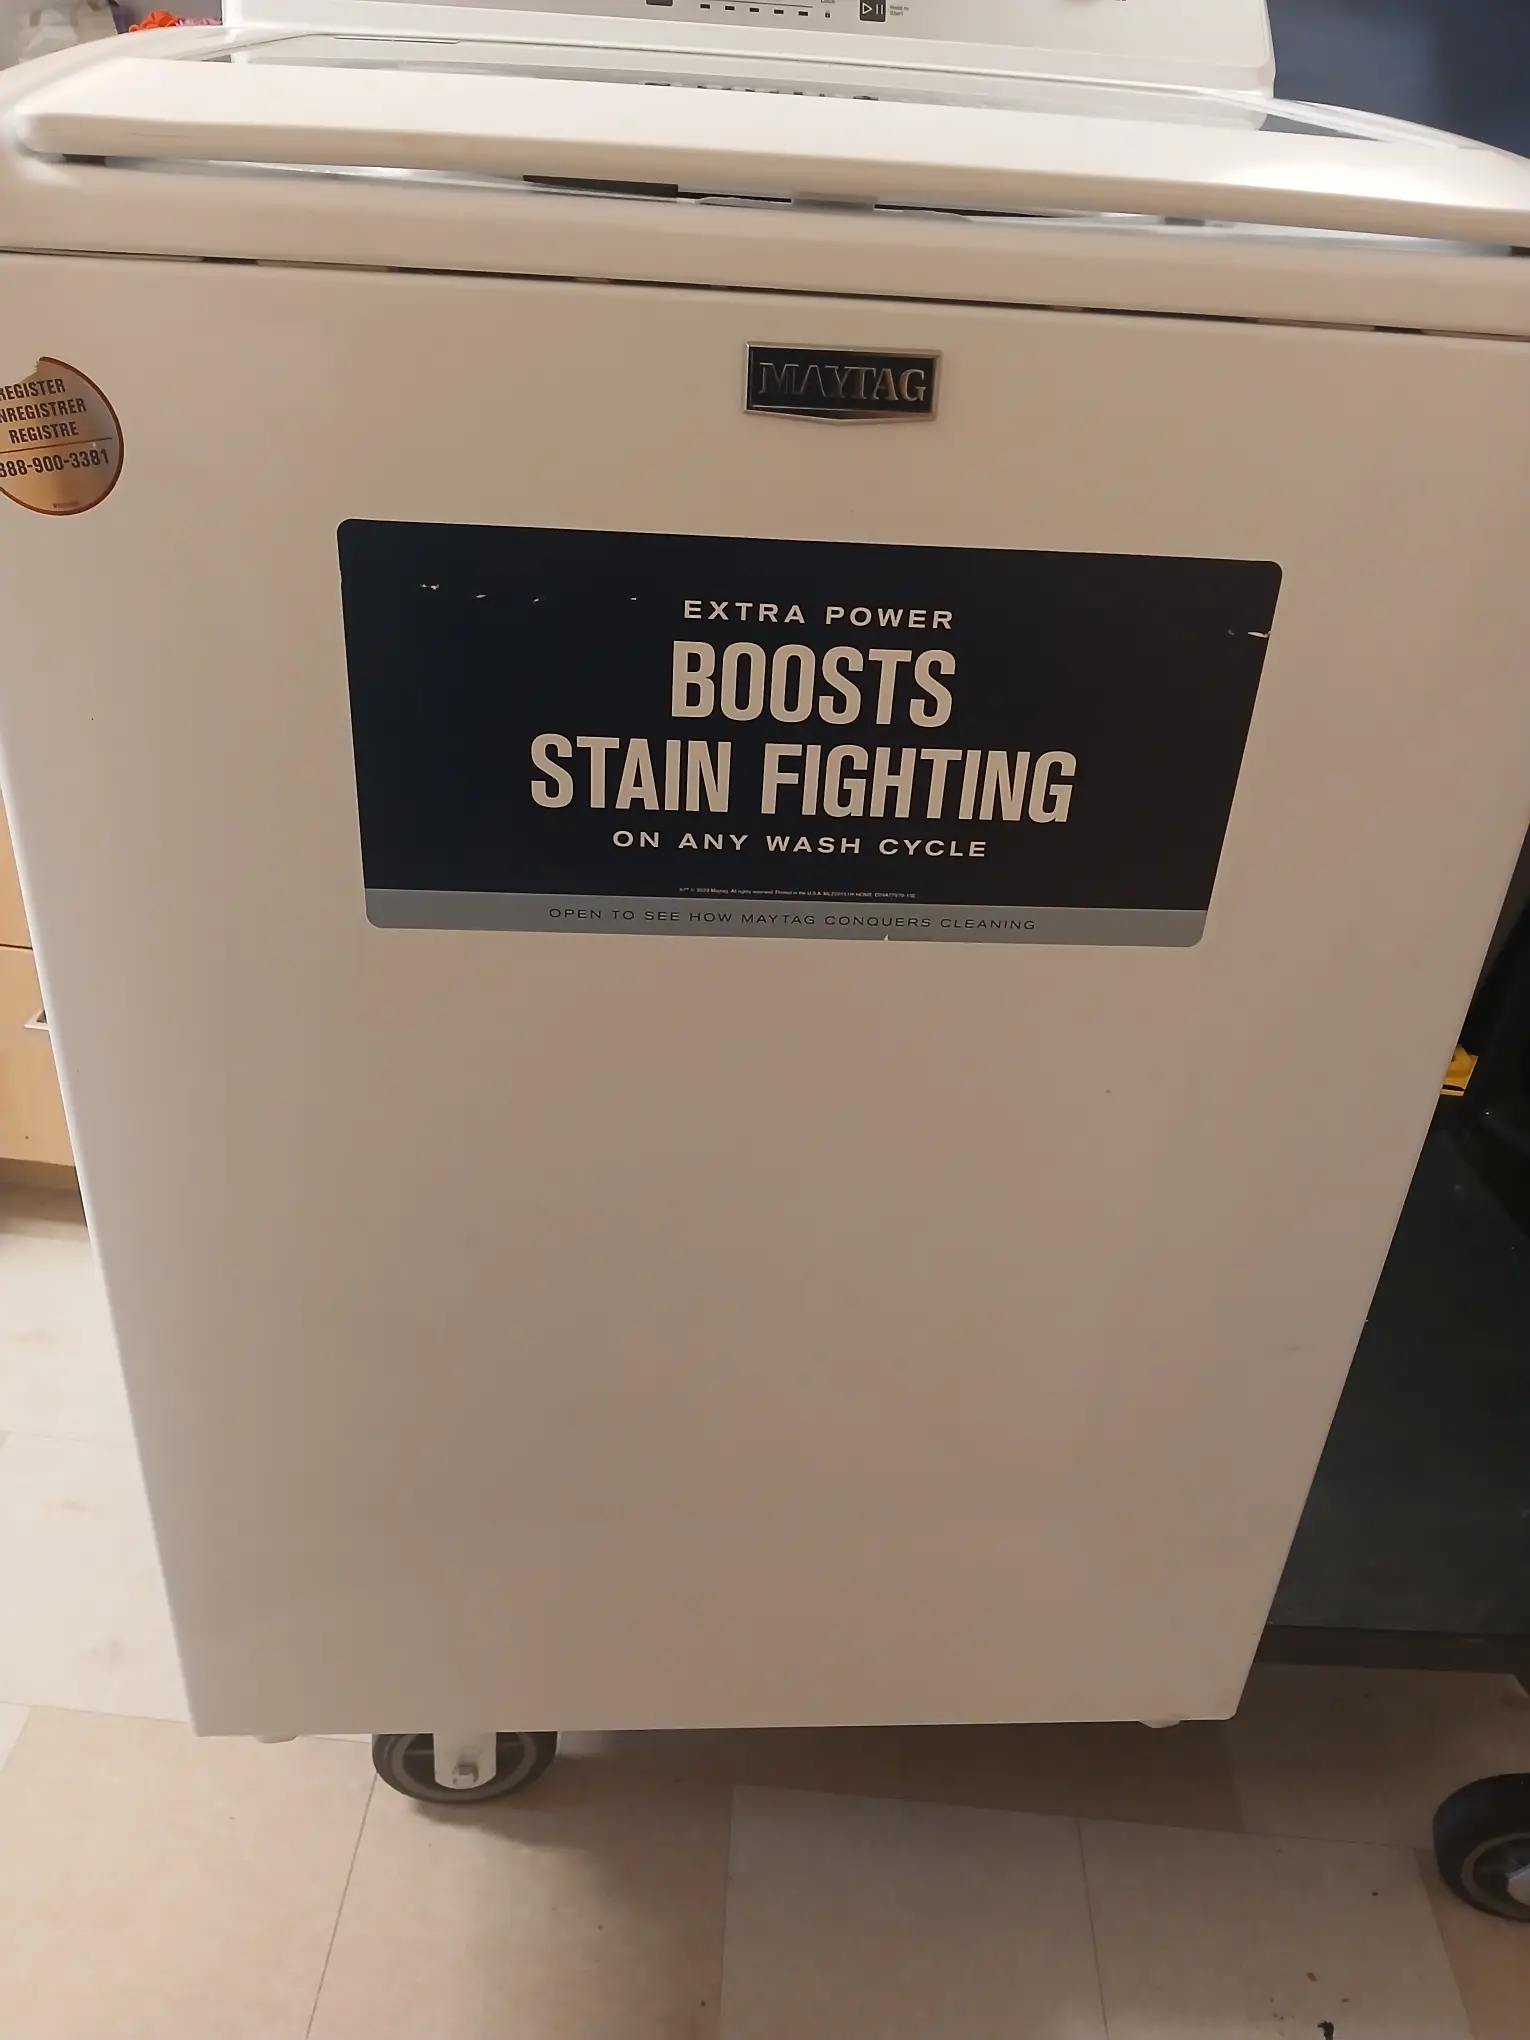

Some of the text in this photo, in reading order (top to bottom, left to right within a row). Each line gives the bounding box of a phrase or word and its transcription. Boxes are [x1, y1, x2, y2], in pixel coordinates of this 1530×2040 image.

[757, 362, 926, 401] MAYTAG
[8, 421, 79, 444] REGISTRE
[684, 600, 953, 630] EXTRA POWER
[671, 640, 956, 728] BOOSTS
[530, 733, 1077, 823] STAIN FIGHTING
[613, 830, 986, 857] ON ANY WASH CYCLE
[549, 908, 1035, 930] OPEN TO SEE HOW MAYTAG CONQUERS CLEANING
